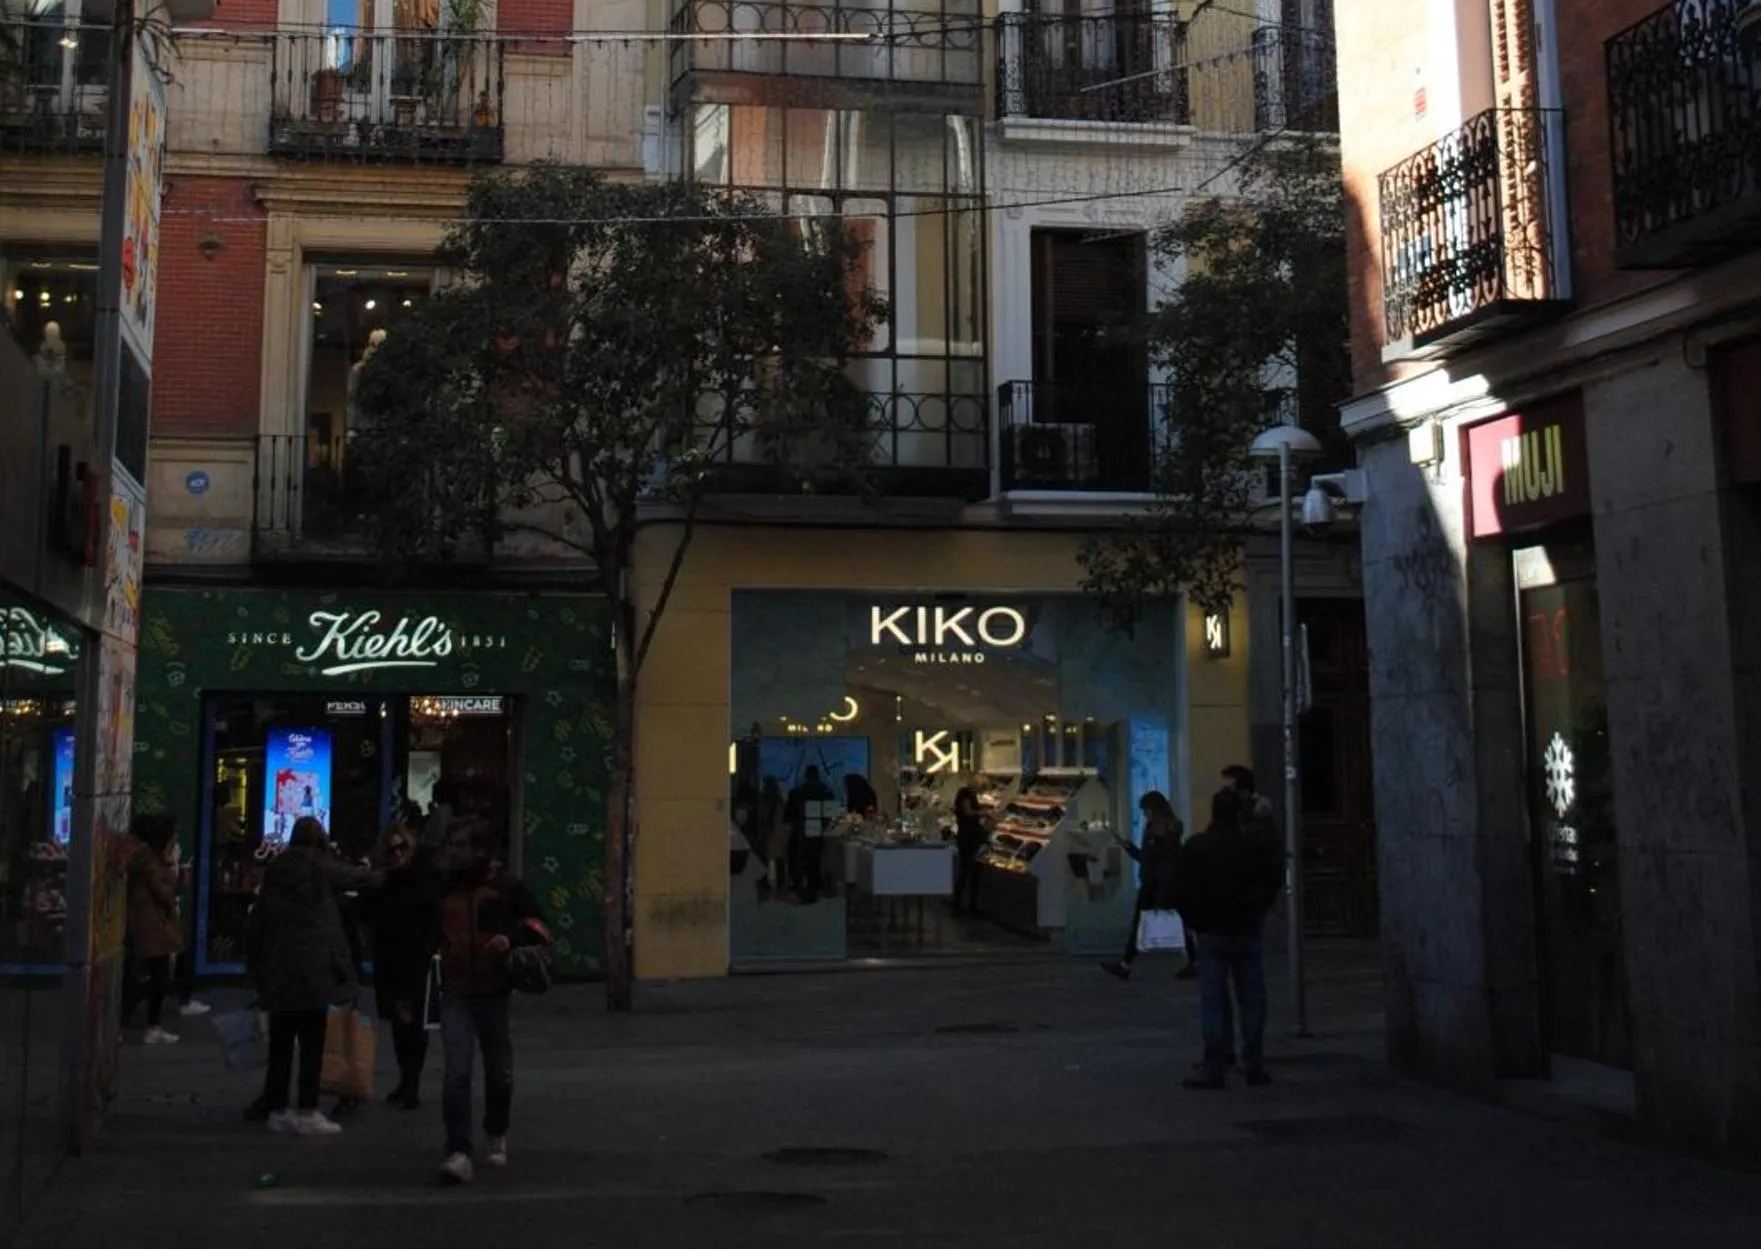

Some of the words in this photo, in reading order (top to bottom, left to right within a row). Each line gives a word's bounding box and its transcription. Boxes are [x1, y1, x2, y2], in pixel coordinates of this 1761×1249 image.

[1501, 423, 1564, 506] MUJI
[227, 632, 293, 646] SINCE
[296, 610, 452, 663] Kiehl's
[871, 606, 1025, 646] KIKO
[914, 653, 985, 664] MILANO
